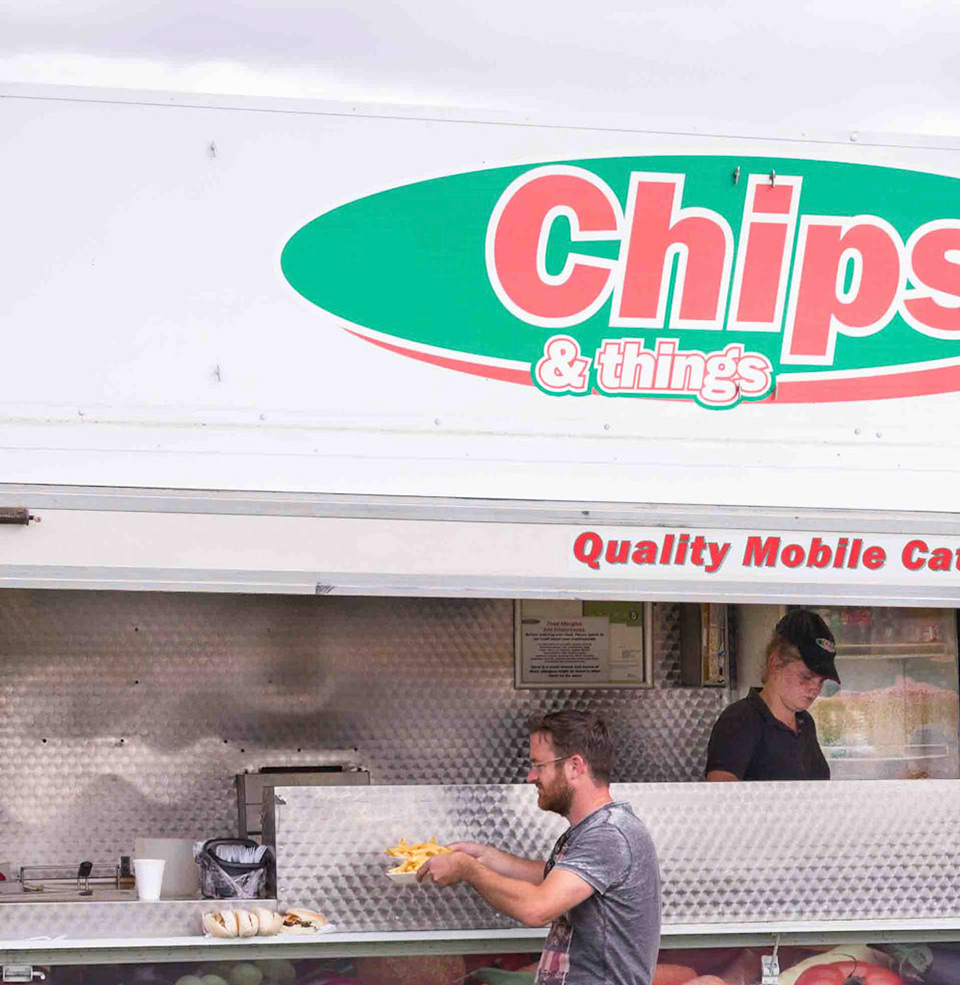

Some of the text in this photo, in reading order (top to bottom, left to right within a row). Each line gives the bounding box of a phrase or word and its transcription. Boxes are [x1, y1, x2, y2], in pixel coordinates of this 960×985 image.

[536, 336, 773, 404] & things
[571, 531, 731, 574] Quality
[741, 535, 887, 570] Mobile
